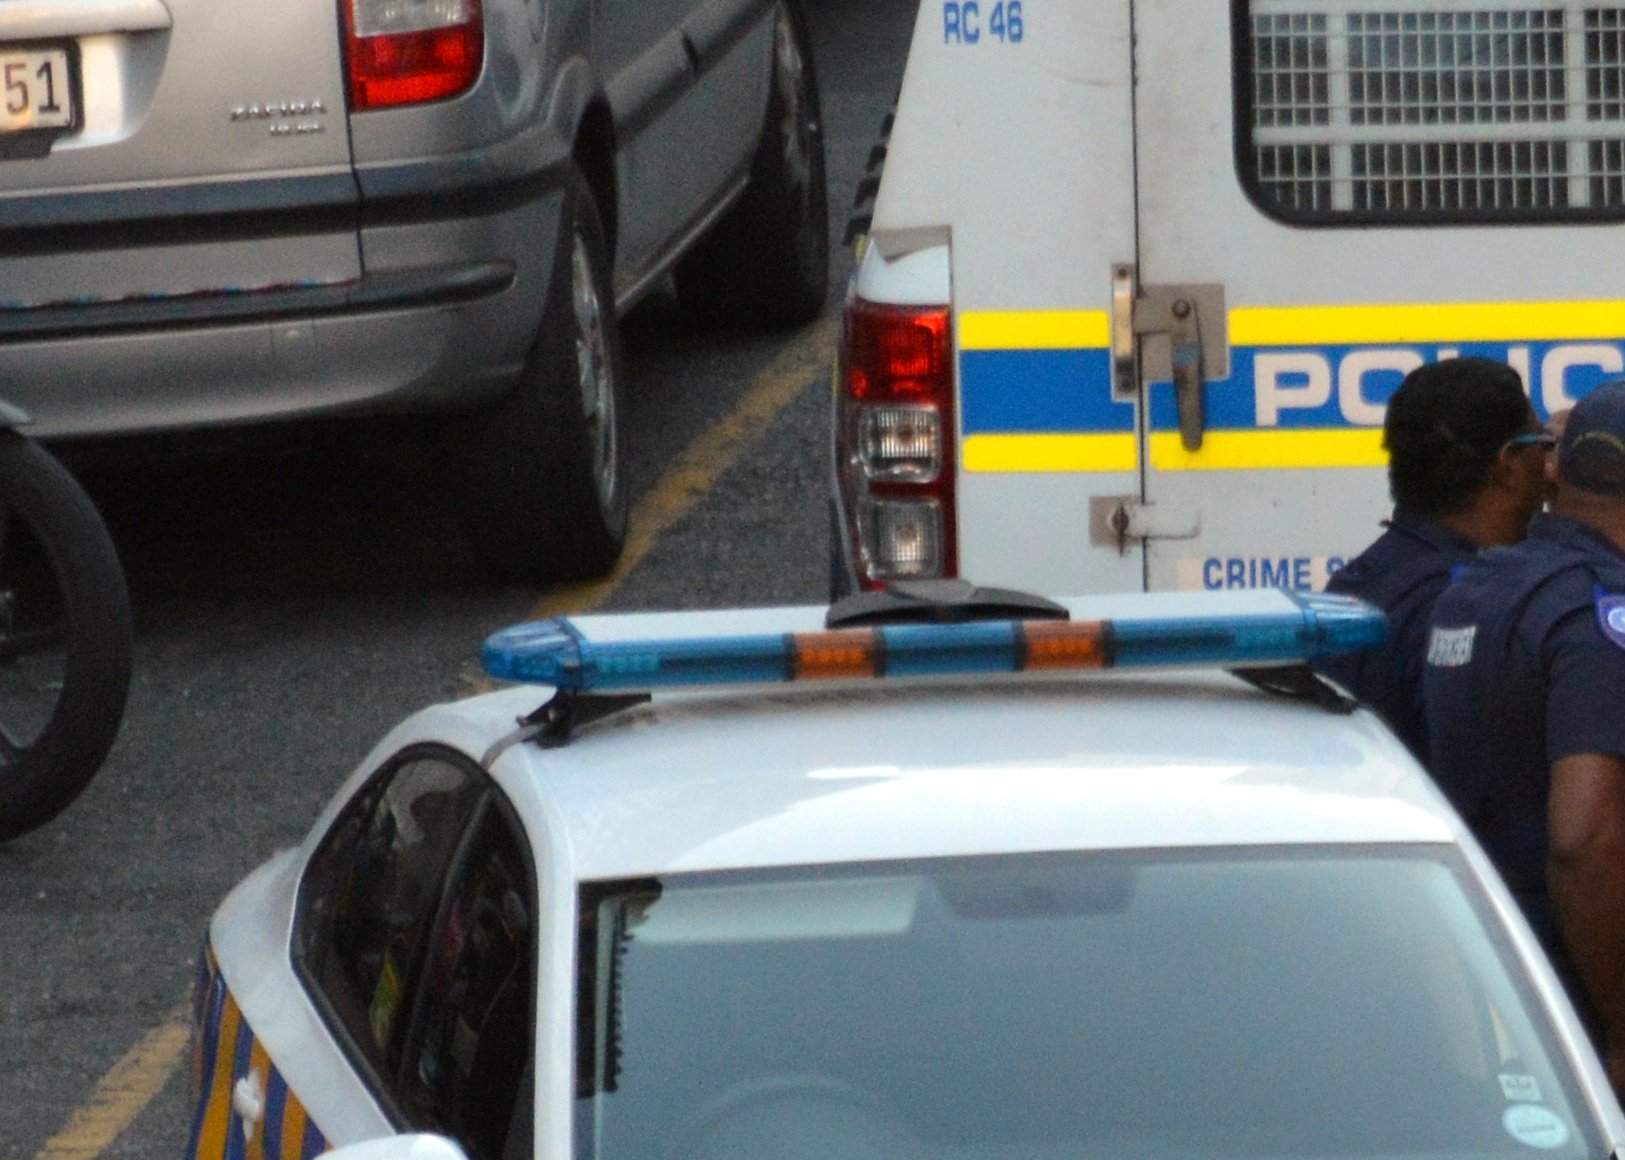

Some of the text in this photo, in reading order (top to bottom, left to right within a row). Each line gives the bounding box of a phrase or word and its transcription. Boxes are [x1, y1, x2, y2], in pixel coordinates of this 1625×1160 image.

[943, 0, 1023, 44] RC 46
[4, 61, 61, 116] 51
[1203, 557, 1313, 591] CRIME
